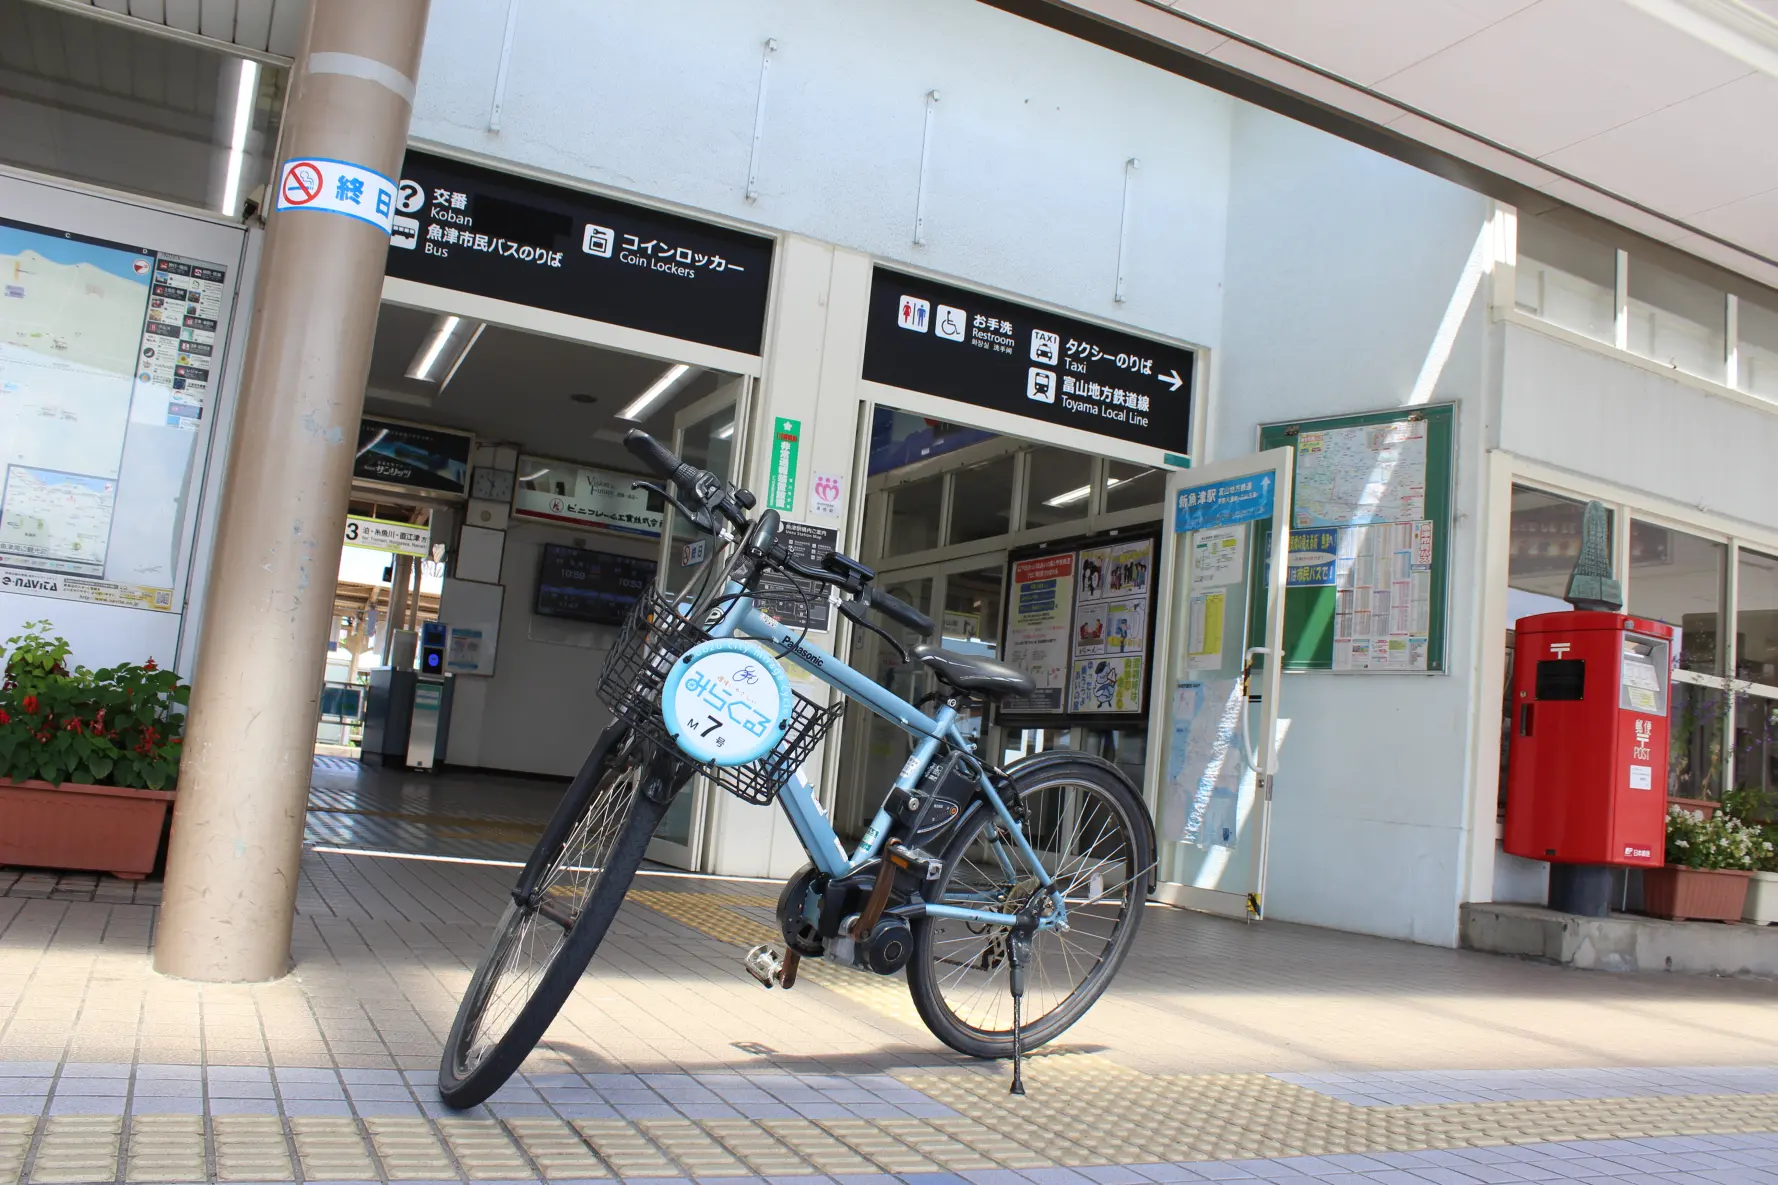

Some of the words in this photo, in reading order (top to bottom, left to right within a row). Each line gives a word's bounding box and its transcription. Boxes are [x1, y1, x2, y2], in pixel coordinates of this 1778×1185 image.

[335, 174, 392, 220] 終日
[432, 187, 468, 211] 交番
[430, 206, 473, 227] Koban
[424, 242, 448, 258] Bus
[426, 223, 564, 268] 魚津市民バスのりば
[622, 233, 745, 273] コインロッカー
[619, 251, 648, 268] Coin
[651, 259, 695, 279] Lockers
[972, 313, 1013, 336] お手洗
[972, 328, 1015, 348] Restroom
[1034, 331, 1058, 344] TAXI
[1064, 357, 1087, 374] Taxi
[1065, 338, 1153, 376] タクシーのりば
[1062, 375, 1150, 412] 富山地方鉄道線
[1061, 395, 1099, 416] Toyama
[1101, 404, 1127, 422] Local
[1128, 411, 1149, 427] Line
[345, 522, 360, 541] 3
[1633, 746, 1651, 760] POST
